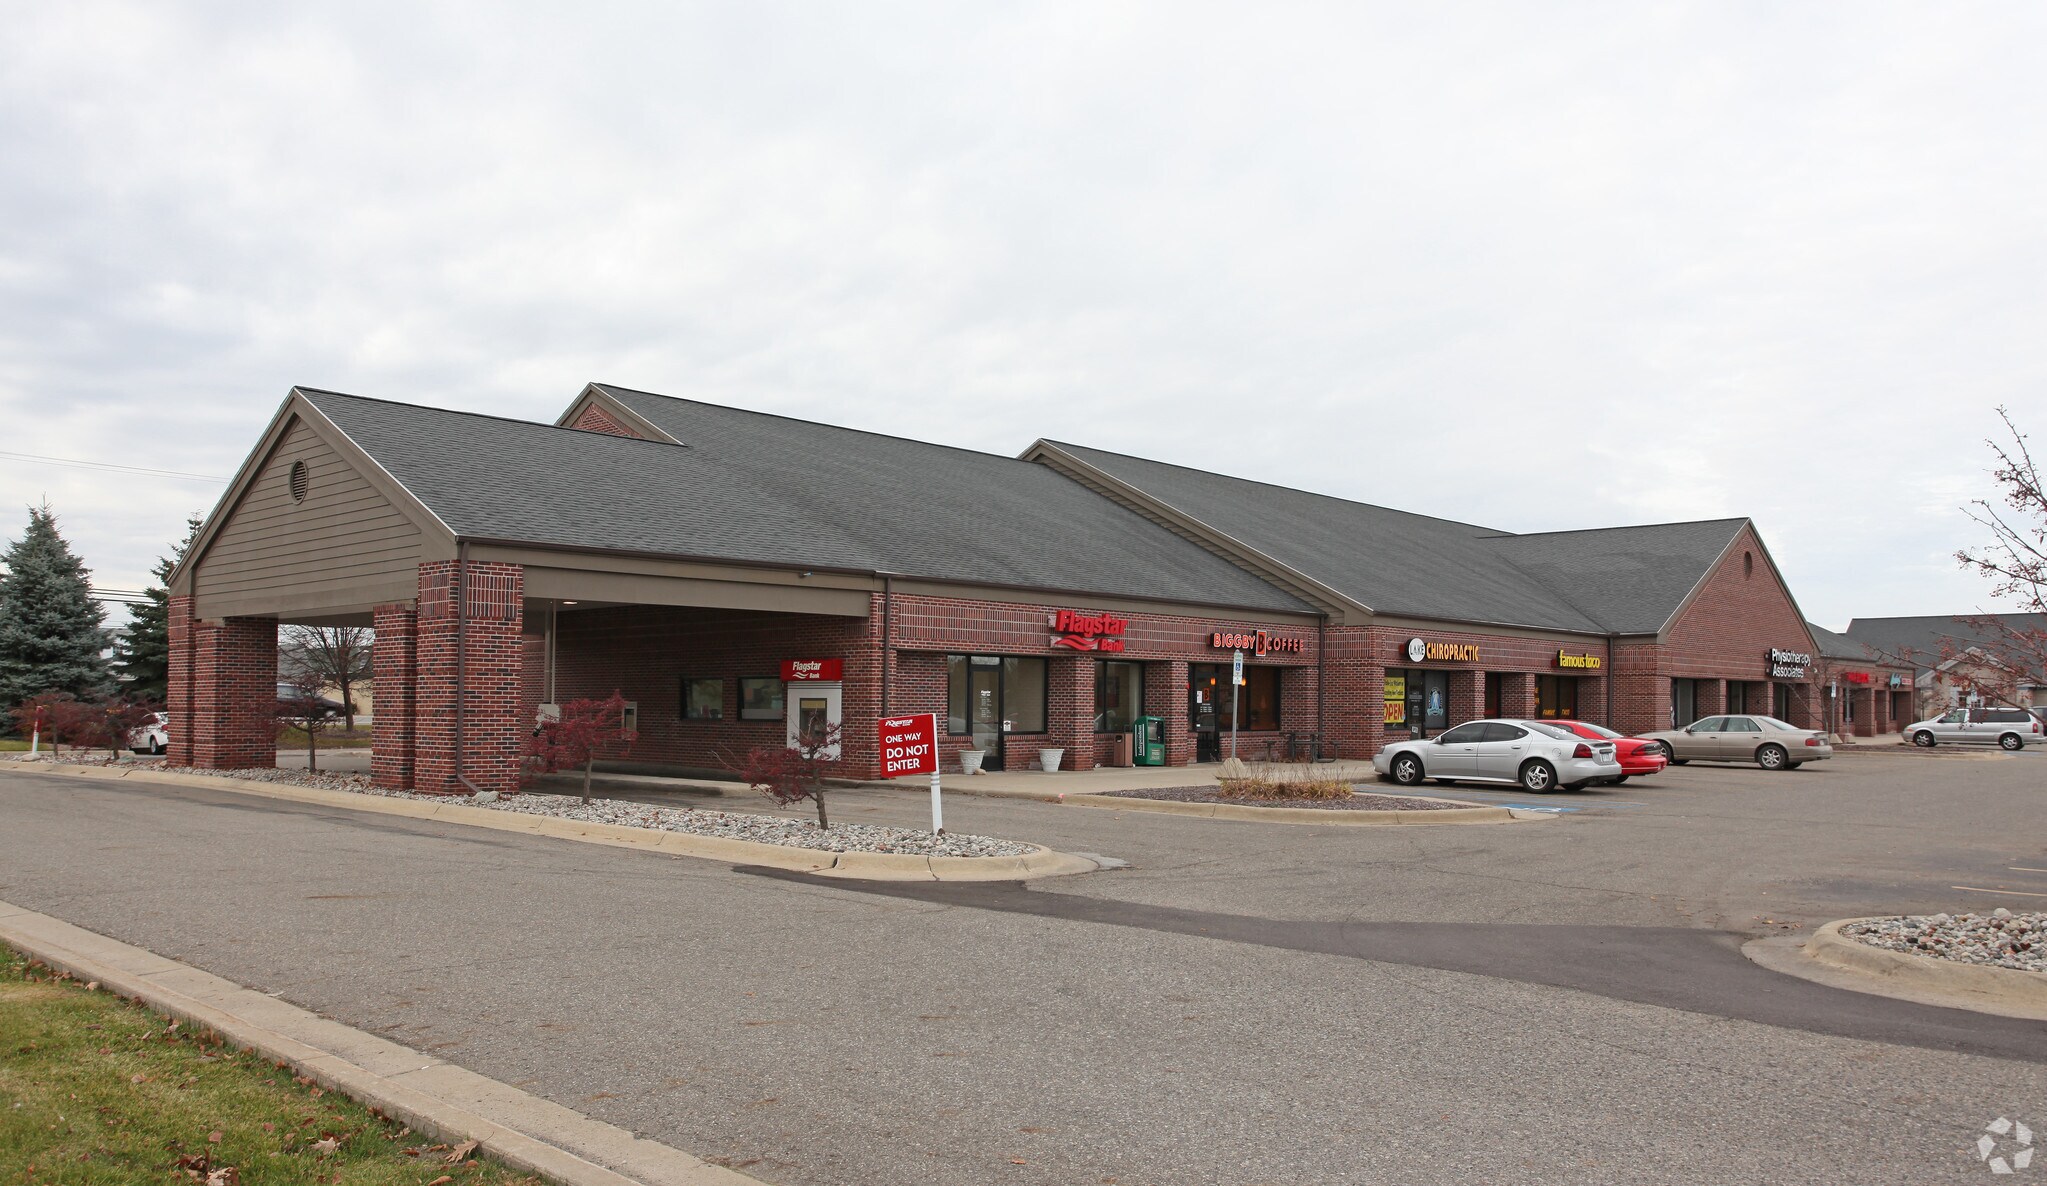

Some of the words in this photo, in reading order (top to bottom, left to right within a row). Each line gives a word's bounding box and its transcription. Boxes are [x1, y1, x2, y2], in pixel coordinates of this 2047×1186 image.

[1056, 610, 1128, 638] Flagstar
[1098, 638, 1125, 652] Bank
[1213, 633, 1256, 649] BIGGBY
[1266, 637, 1304, 652] COFFEE
[1410, 644, 1425, 656] LAKE
[1426, 642, 1479, 661] CHIROPRACTIC
[1559, 649, 1585, 668] famous
[1585, 653, 1601, 669] taco
[1771, 648, 1811, 667] Physiotherapy
[792, 661, 822, 672] Flagstar
[1772, 664, 1804, 678] Associates
[1384, 703, 1404, 721] OPEN
[885, 734, 903, 744] ONE
[903, 732, 922, 742] WAY
[886, 747, 904, 759] DO
[905, 744, 929, 757] NOT
[887, 758, 920, 772] ENTER
